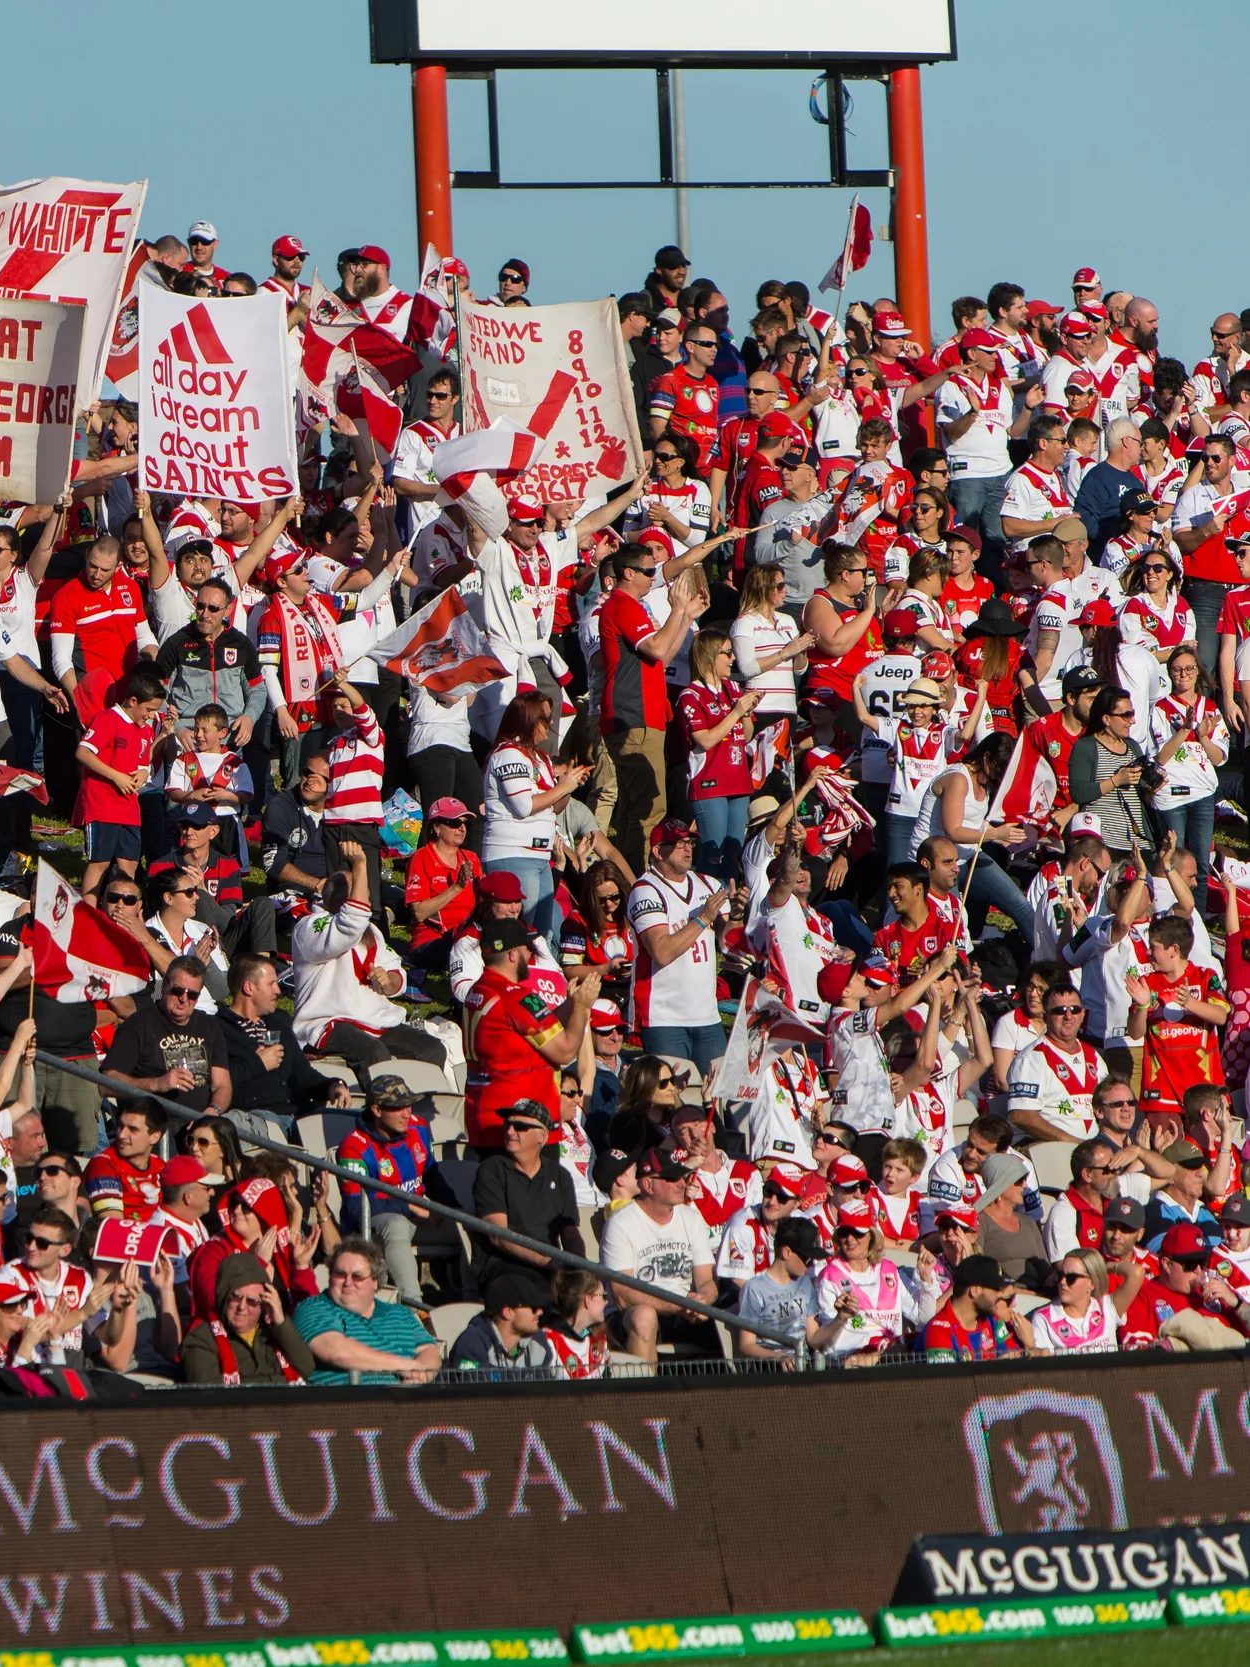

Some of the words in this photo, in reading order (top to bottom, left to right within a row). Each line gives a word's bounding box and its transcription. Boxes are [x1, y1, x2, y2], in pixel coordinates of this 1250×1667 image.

[9, 200, 133, 257] WHITE
[470, 333, 525, 364] STAND
[568, 330, 583, 354] 8
[153, 339, 173, 383] all
[178, 355, 248, 402] day
[572, 358, 590, 382] 9
[573, 383, 602, 403] 10
[151, 386, 158, 418] i
[161, 394, 260, 433] dream
[576, 406, 602, 425] 11
[159, 427, 249, 468] about
[579, 424, 608, 448] 12
[144, 455, 296, 499] SAINTS
[295, 623, 310, 662] RED
[874, 664, 913, 681] Jeep
[692, 940, 708, 963] 21
[537, 979, 555, 993] GO
[159, 1035, 205, 1051] GALWAY
[1010, 1084, 1038, 1094] GLOBE
[931, 1182, 963, 1196] GLOBE
[779, 1304, 791, 1318] N
[794, 1299, 805, 1315] Y
[923, 1534, 1250, 1595] McGUIGAN
[883, 1606, 1046, 1639] bet365.com
[1052, 1604, 1095, 1627] 1800
[1094, 1602, 1129, 1624] 365
[1128, 1598, 1167, 1622] 365
[580, 1623, 744, 1654] bet365.com
[751, 1620, 795, 1643] 1800
[796, 1618, 832, 1639] 365
[832, 1616, 868, 1637] 365
[265, 1640, 438, 1666] bet365.com
[444, 1640, 490, 1661] 1800
[491, 1639, 529, 1660] 365
[529, 1637, 567, 1659] 365
